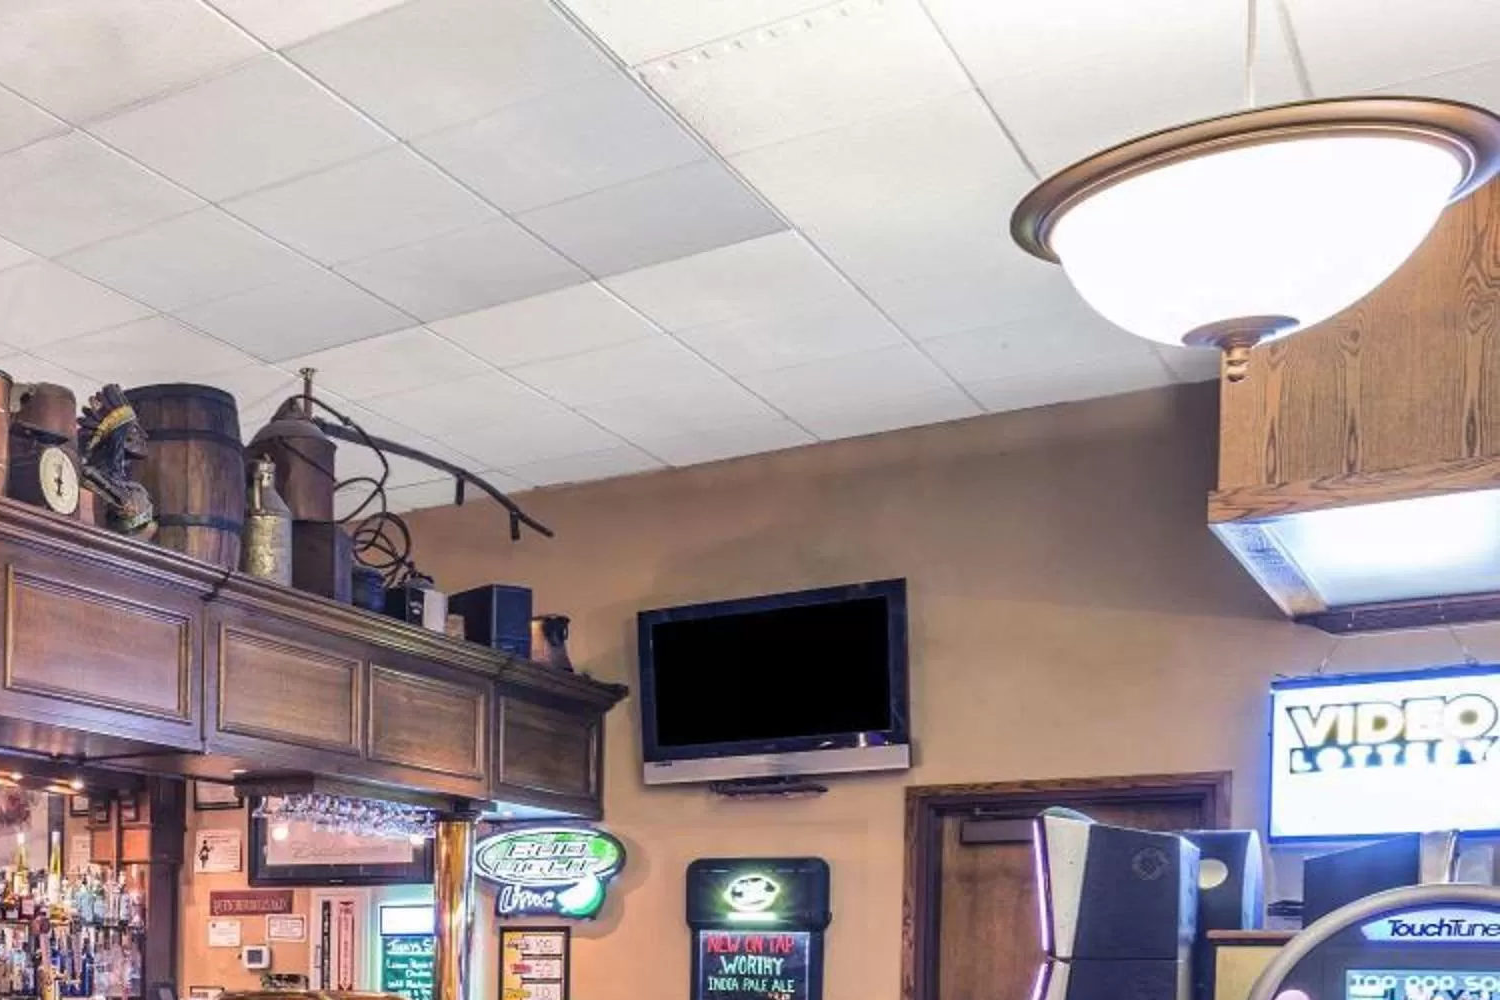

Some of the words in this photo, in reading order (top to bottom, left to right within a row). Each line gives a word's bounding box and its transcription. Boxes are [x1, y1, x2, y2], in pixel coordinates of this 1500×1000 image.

[1285, 694, 1500, 747] VIDEO
[1388, 918, 1500, 937] TouchTune
[707, 932, 740, 953] NEW
[744, 935, 764, 953] ON
[769, 935, 795, 954] TAP
[720, 954, 785, 976] WORTHY
[707, 976, 739, 991] INDIA
[743, 977, 768, 991] PALE
[771, 979, 796, 993] ALE
[1463, 976, 1500, 991] SO
